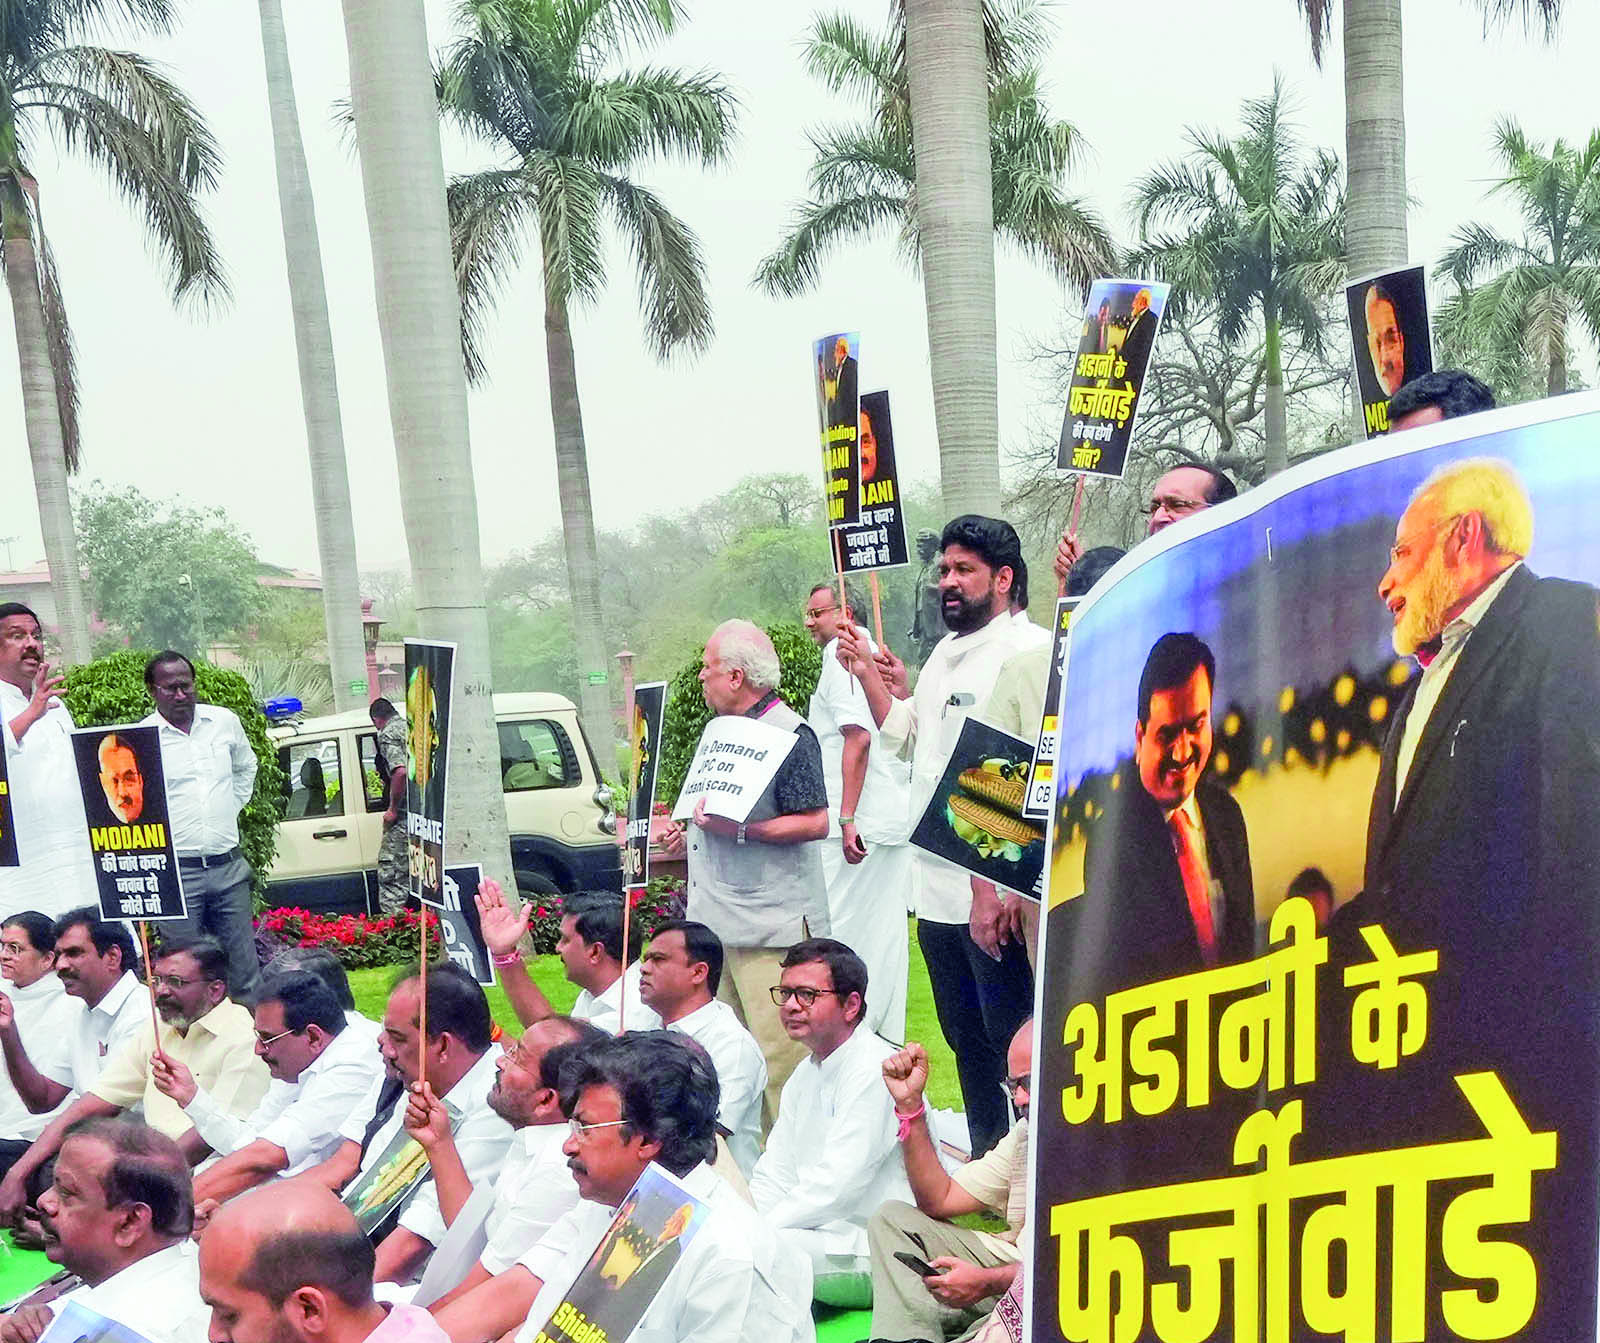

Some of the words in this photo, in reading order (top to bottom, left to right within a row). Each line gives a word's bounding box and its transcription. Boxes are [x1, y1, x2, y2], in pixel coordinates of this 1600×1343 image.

[709, 740, 769, 762] Demand
[716, 761, 735, 773] on
[705, 780, 744, 796] scam
[91, 824, 166, 851] MODANI
[1061, 896, 1329, 1126] अडानी
[1344, 925, 1439, 1069] के
